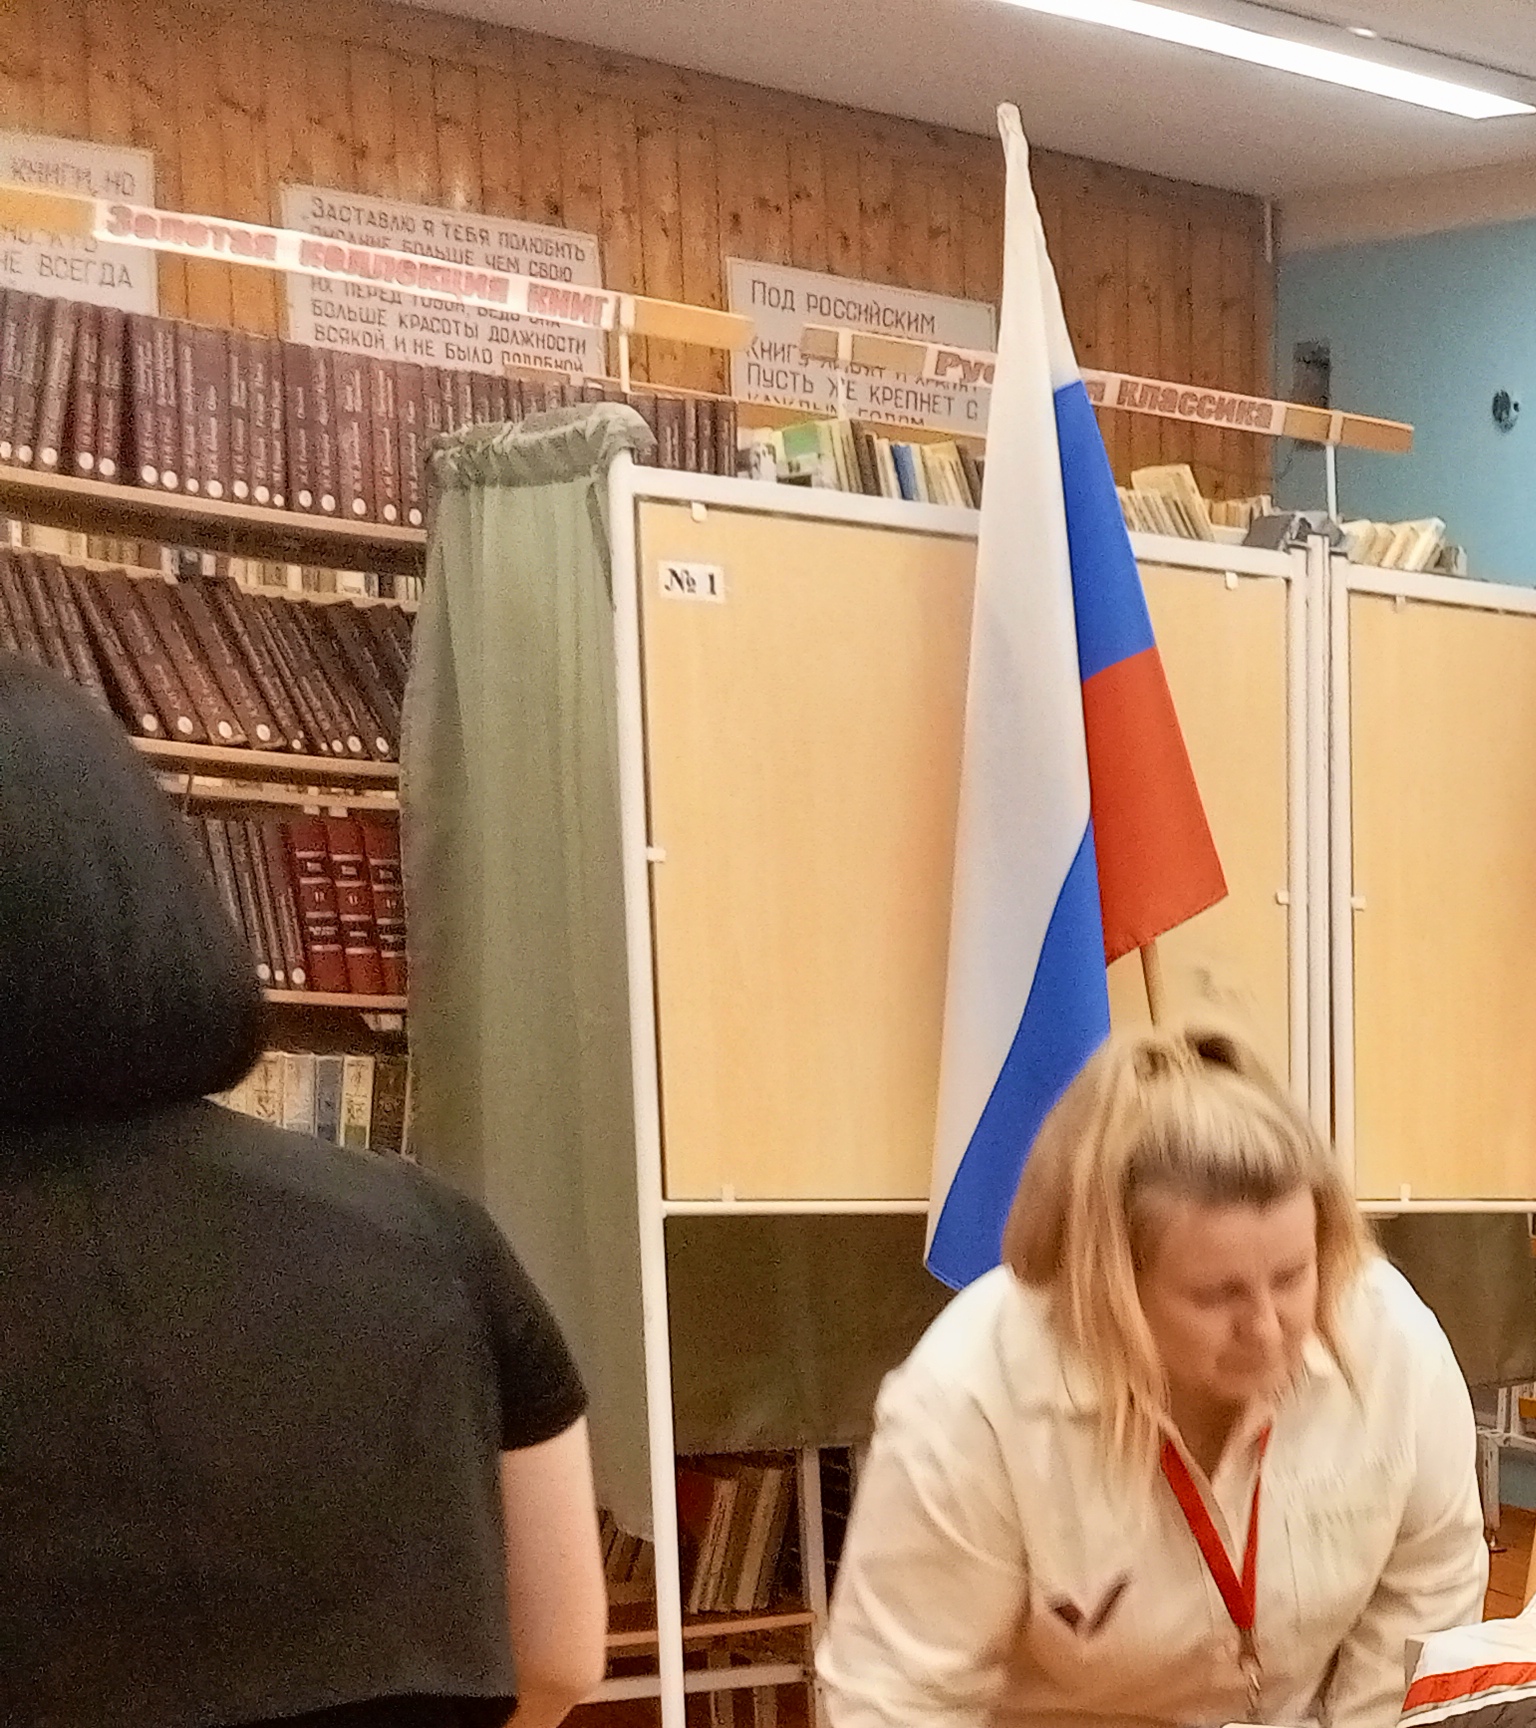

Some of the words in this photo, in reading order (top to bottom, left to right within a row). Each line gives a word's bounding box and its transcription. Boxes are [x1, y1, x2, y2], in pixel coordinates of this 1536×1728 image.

[311, 196, 416, 235] ЗАСТАВЛЮ
[423, 218, 435, 238] Я
[442, 221, 491, 247] ТЕБЯ
[498, 230, 586, 263] ПОЛЮБИТЬ
[38, 251, 134, 289] ВСЕГДА
[485, 252, 520, 275] ЧЕМ
[311, 297, 387, 327] БОЛЬШЕ
[399, 311, 479, 340] КРАСОТЫ
[488, 324, 587, 356] ДОЛЖНОСТИ
[806, 291, 936, 335] РОССИЙСКИМ
[394, 334, 407, 354] И
[413, 338, 436, 358] НЕ
[445, 341, 493, 366] БЫЛО
[747, 361, 815, 394] ПУСТЬ
[869, 383, 956, 417] КРЕПНЕТ
[1116, 379, 1275, 429] классика
[663, 568, 698, 595] №
[704, 572, 719, 598] 1
